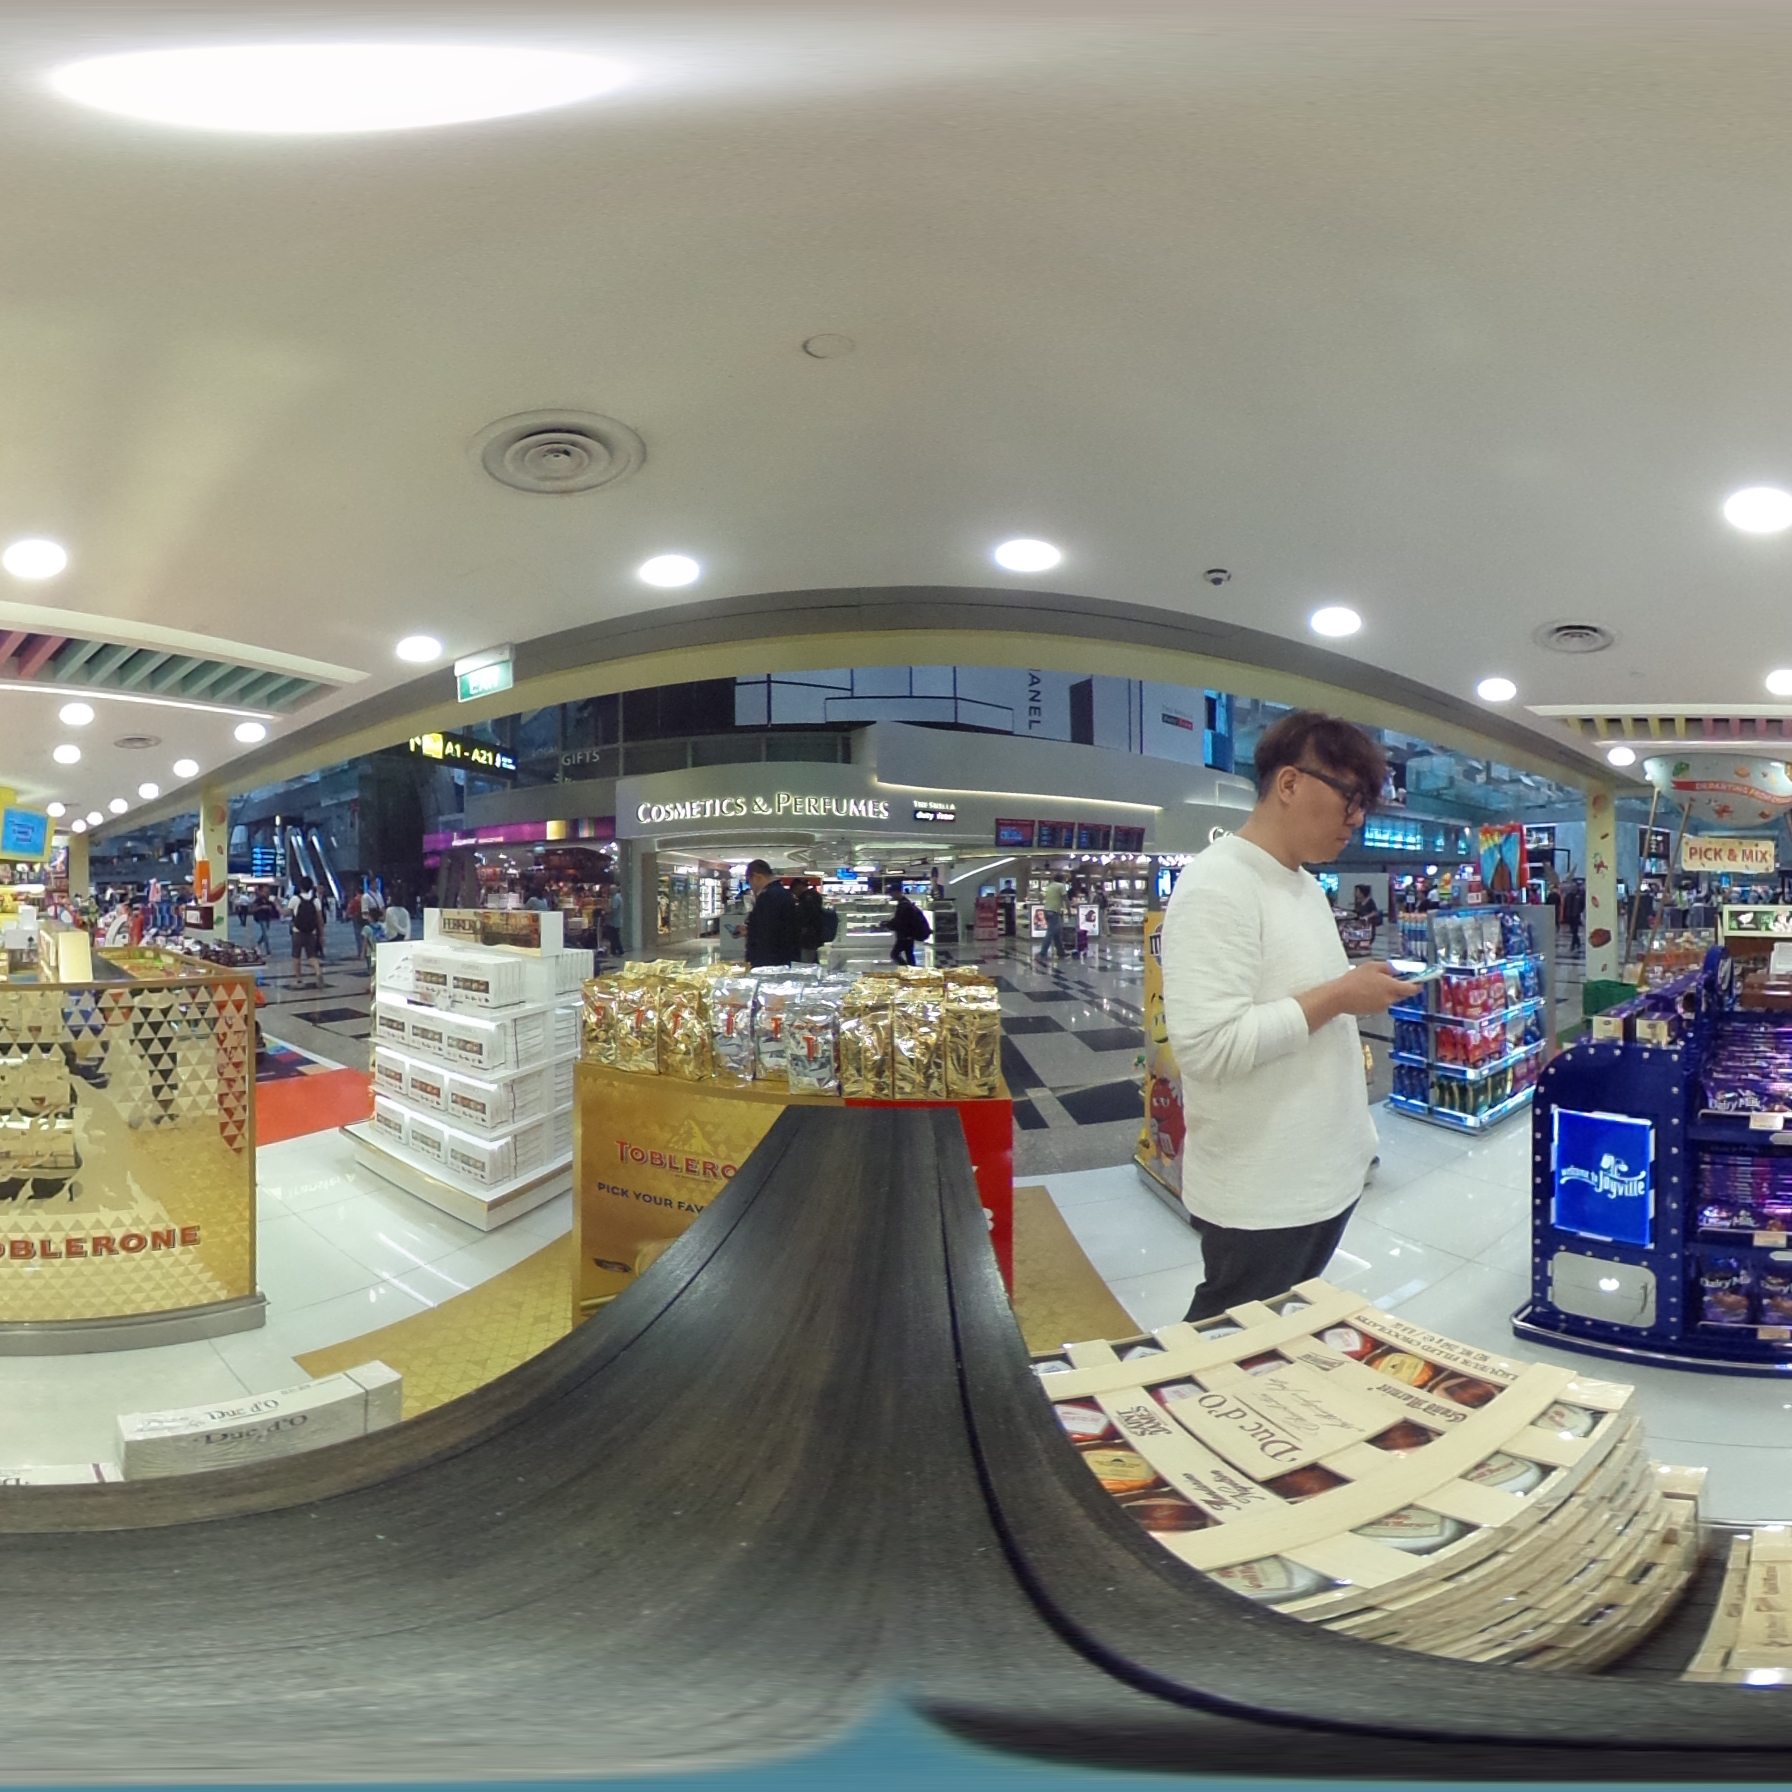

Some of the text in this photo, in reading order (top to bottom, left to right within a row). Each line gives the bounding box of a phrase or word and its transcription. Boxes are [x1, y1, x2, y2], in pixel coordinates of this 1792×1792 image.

[1028, 668, 1043, 730] ANEL
[445, 742, 461, 758] A1
[471, 748, 493, 765] A21
[562, 750, 600, 766] GIFTS
[637, 792, 890, 824] COSMETICS & PERFUMES
[1688, 846, 1768, 863] PICK & MIX
[615, 1139, 739, 1181] TOBLERO
[598, 1181, 706, 1215] PICK YOUR FAV
[1594, 1169, 1646, 1200] Joyville
[1354, 1314, 1421, 1348] CHOCOLATES
[207, 1399, 280, 1423] Duc d'O
[1198, 1392, 1248, 1422] d'O
[1374, 1383, 1426, 1409] Marnier
[1115, 1407, 1148, 1438] SAINT
[1129, 1404, 1173, 1438] JAMES
[1421, 1401, 1468, 1424] Grand
[195, 1413, 309, 1446] Duc d'O
[1238, 1418, 1303, 1466] Duc
